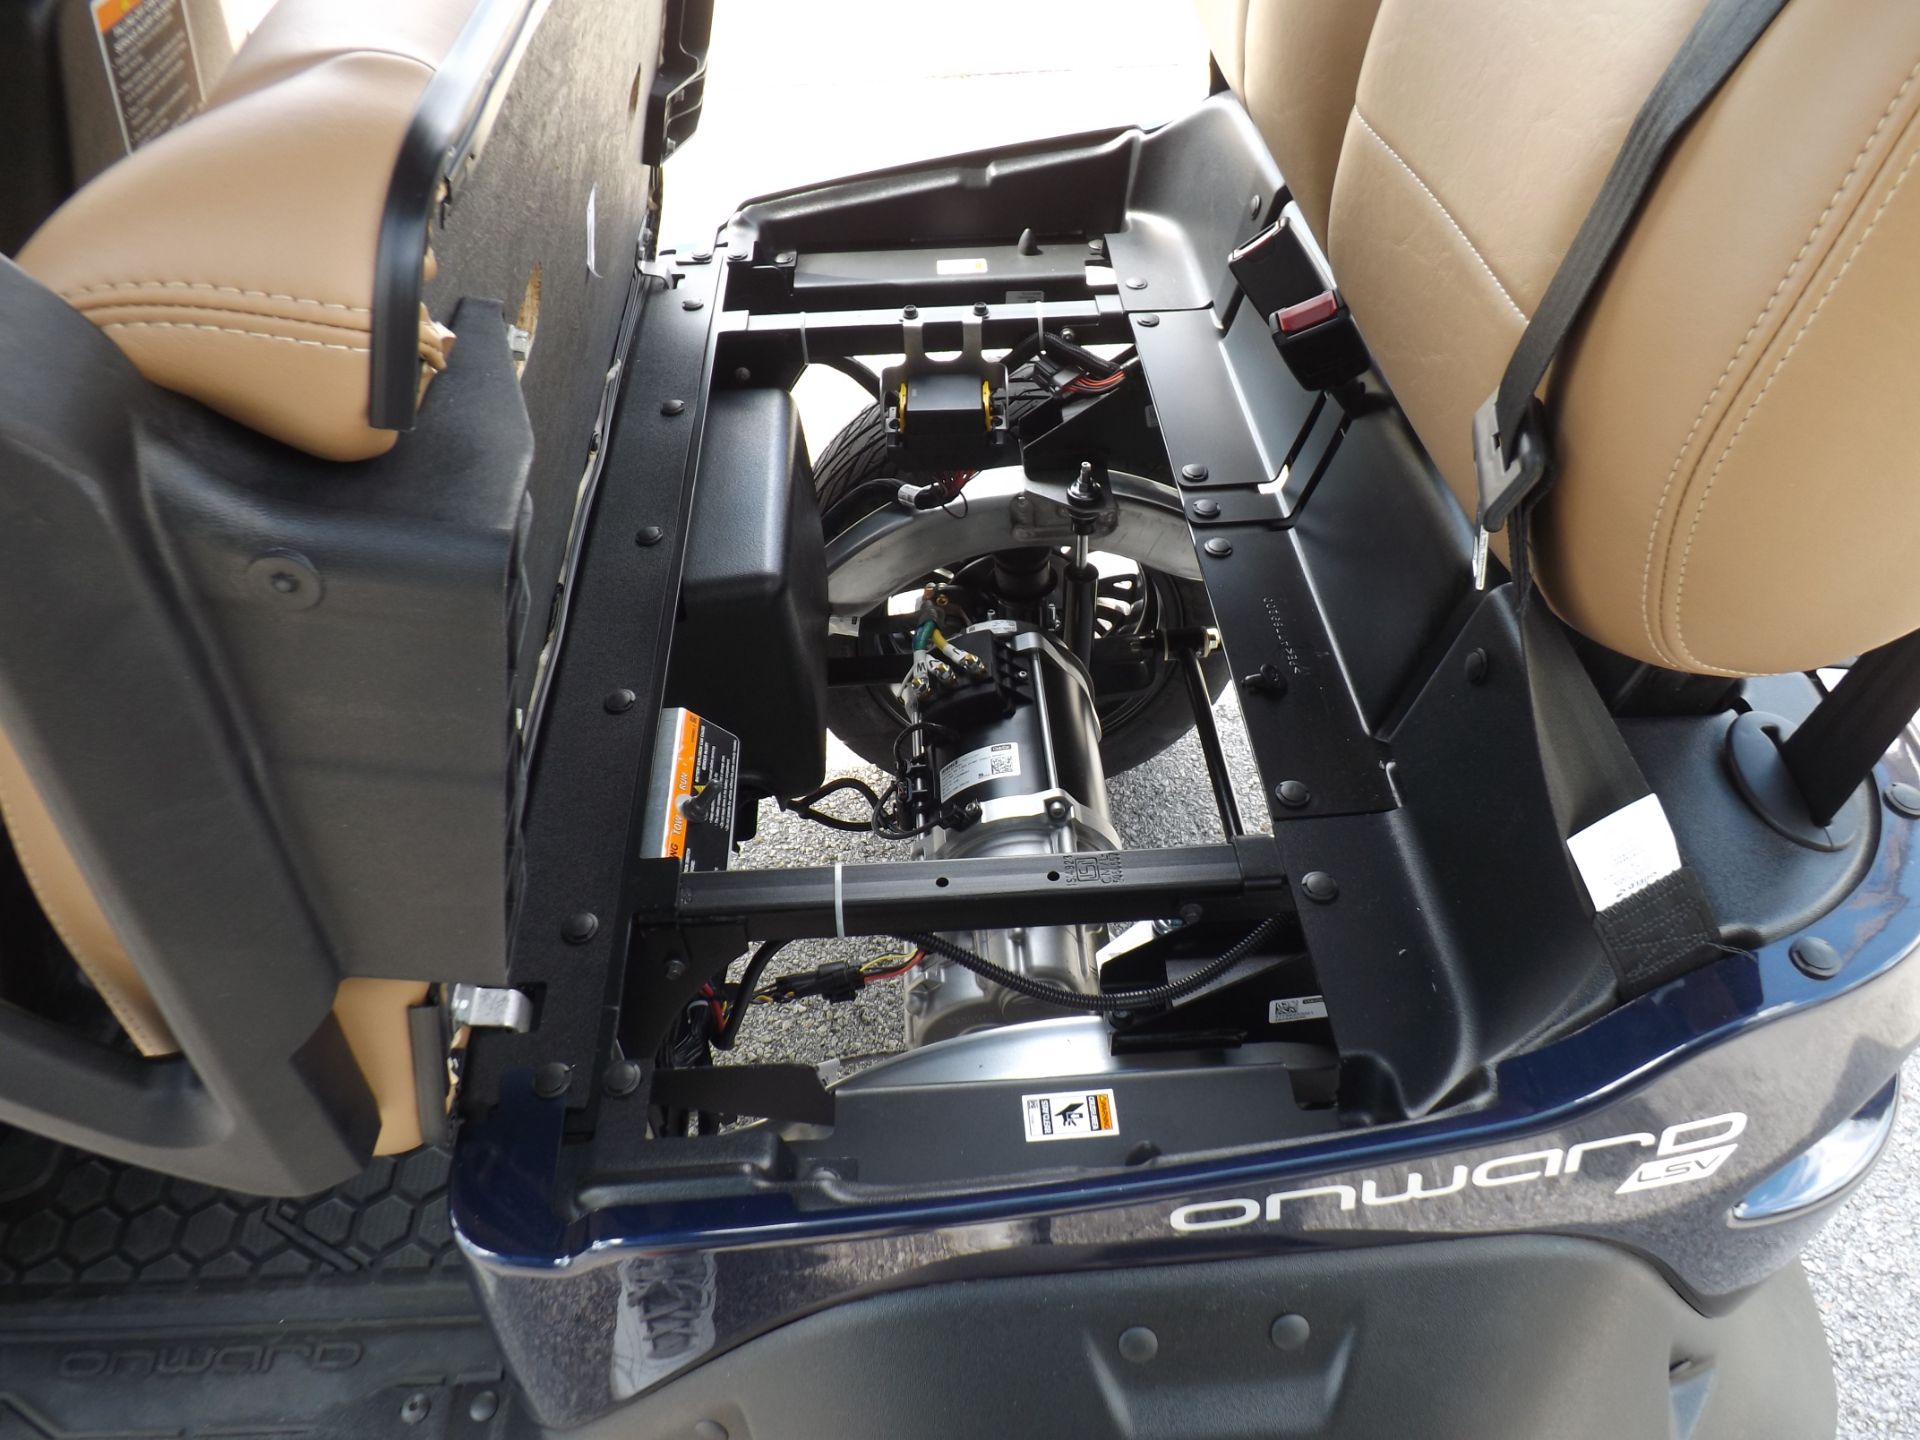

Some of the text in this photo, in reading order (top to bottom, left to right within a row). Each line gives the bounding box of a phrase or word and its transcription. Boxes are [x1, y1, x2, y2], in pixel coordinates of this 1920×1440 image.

[679, 772, 688, 790] RUN
[672, 816, 683, 835] TOW
[1636, 1154, 1722, 1183] LSV
